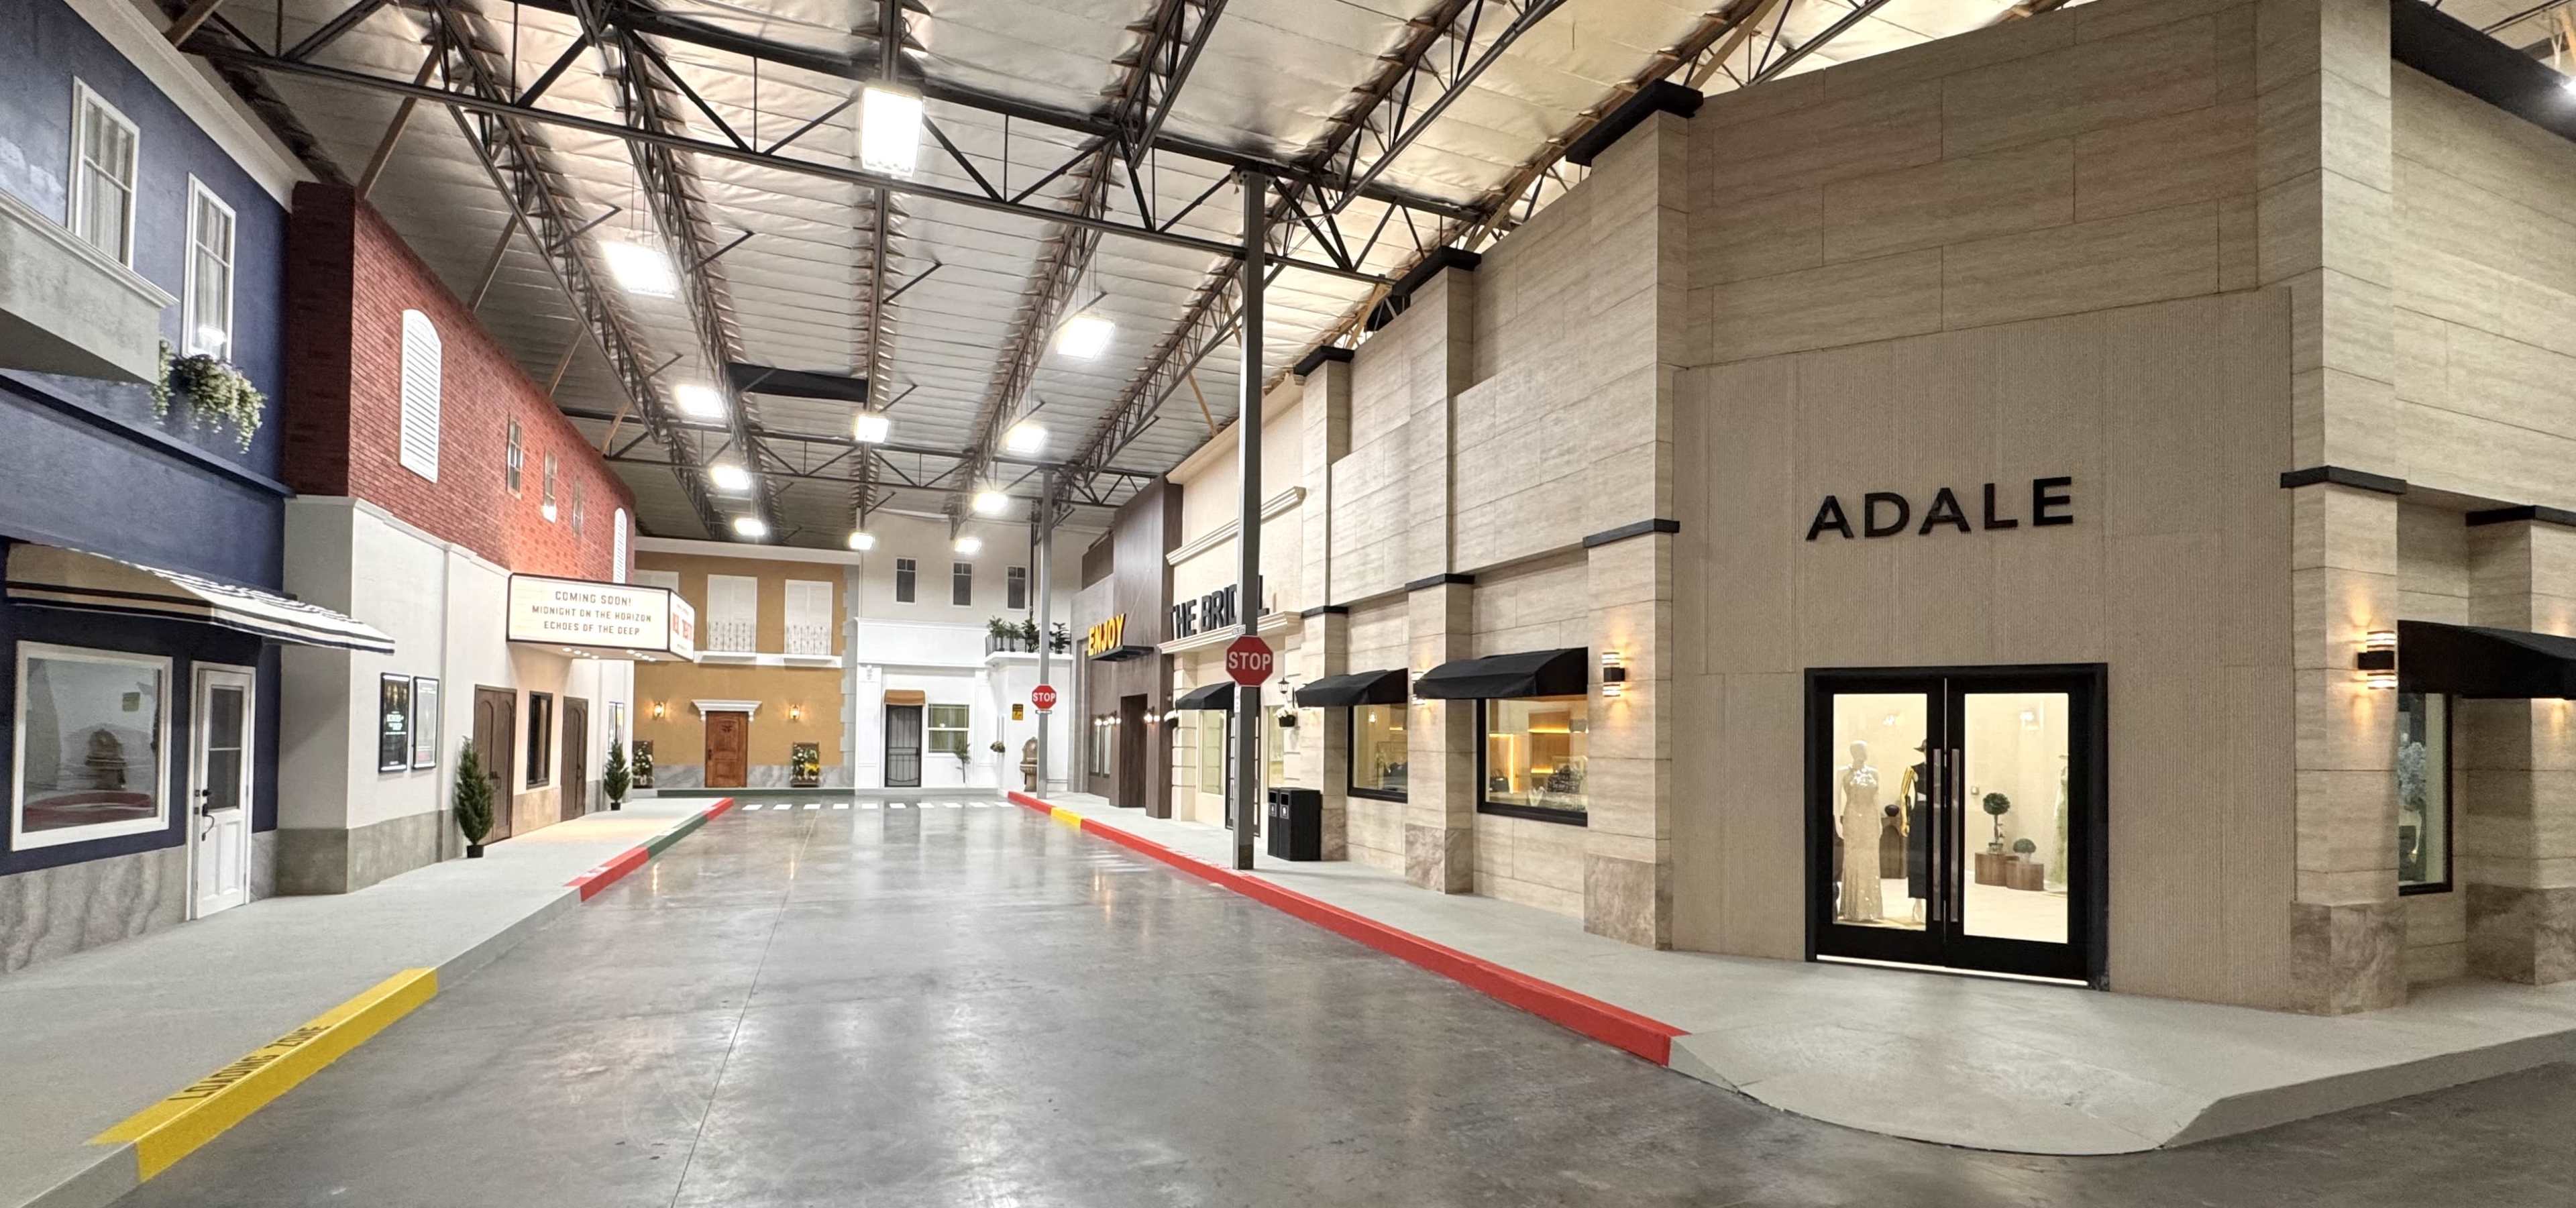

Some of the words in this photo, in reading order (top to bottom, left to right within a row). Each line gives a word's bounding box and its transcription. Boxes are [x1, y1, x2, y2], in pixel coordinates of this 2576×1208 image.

[1805, 476, 2074, 541] ADALE
[555, 591, 596, 603] COMING
[600, 595, 631, 606] SOON!
[1169, 599, 1197, 641] THE
[1201, 575, 1270, 633] BRIDL
[532, 605, 576, 616] MIDNIGHT
[580, 609, 591, 617] ON
[595, 610, 611, 619] THE
[614, 612, 651, 622] HORIZON
[544, 621, 579, 630] ECHOES
[583, 624, 594, 632] OF
[598, 624, 614, 634] THE
[618, 626, 640, 635] DEEP
[1088, 613, 1126, 657] ENJOY
[1228, 651, 1271, 671] STOP
[1032, 692, 1055, 702] STOP
[167, 1054, 281, 1100] LOADING
[263, 1026, 331, 1049] ZONE
